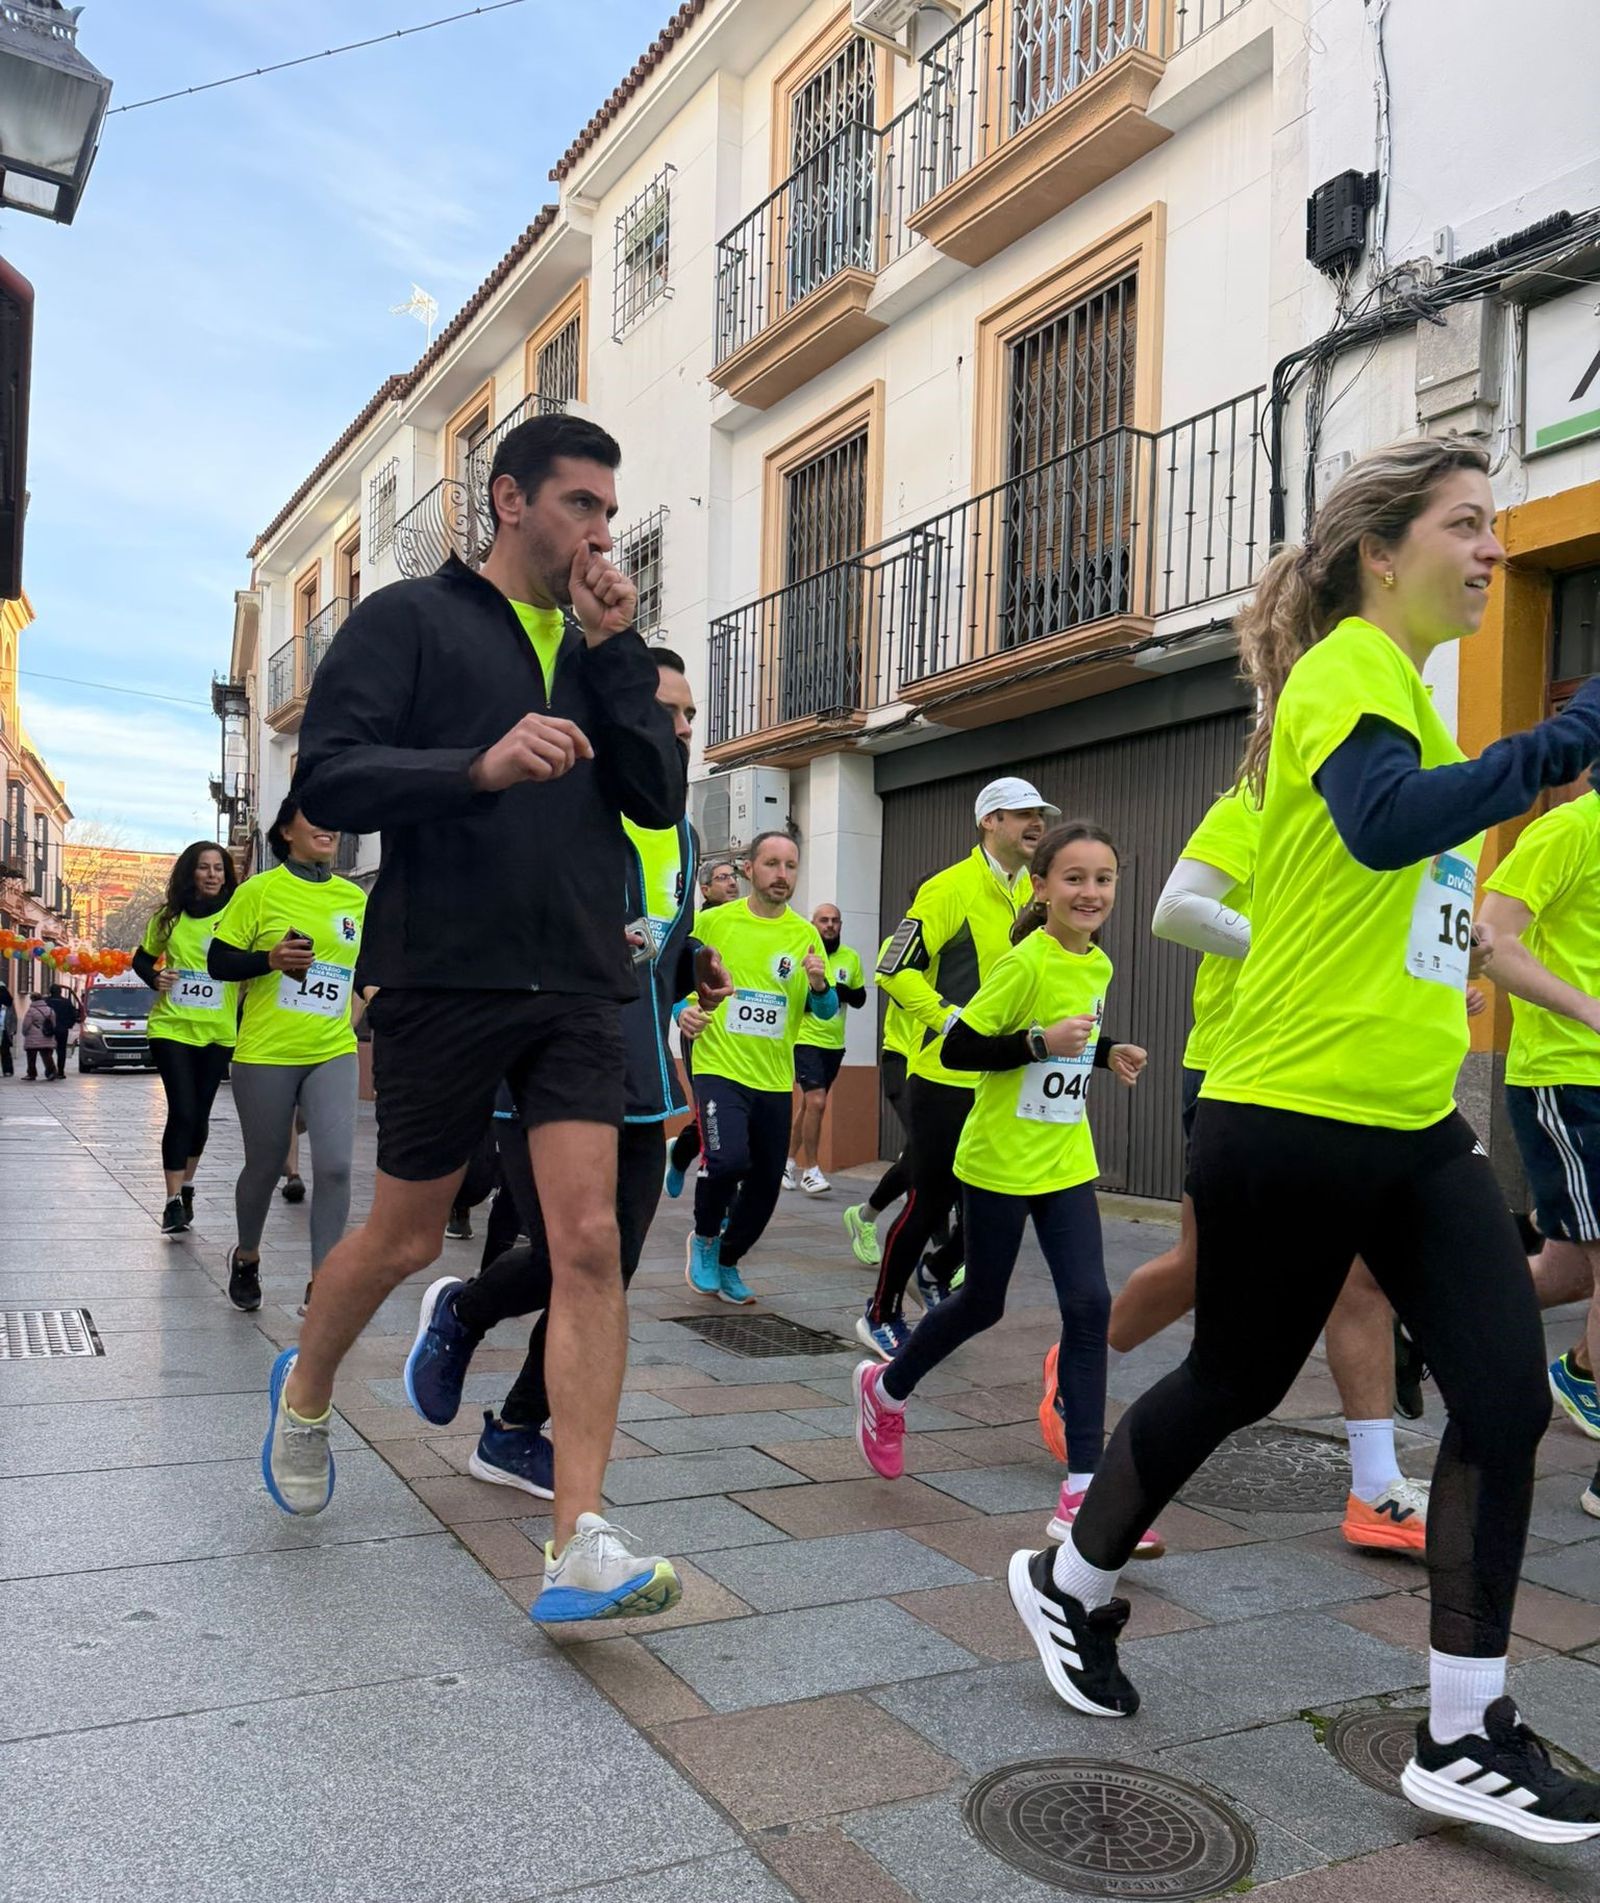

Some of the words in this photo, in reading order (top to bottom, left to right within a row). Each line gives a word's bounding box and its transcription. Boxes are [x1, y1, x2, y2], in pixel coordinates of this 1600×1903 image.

[181, 983, 213, 998] 140
[297, 979, 339, 1001] 145
[739, 1005, 777, 1025] 038
